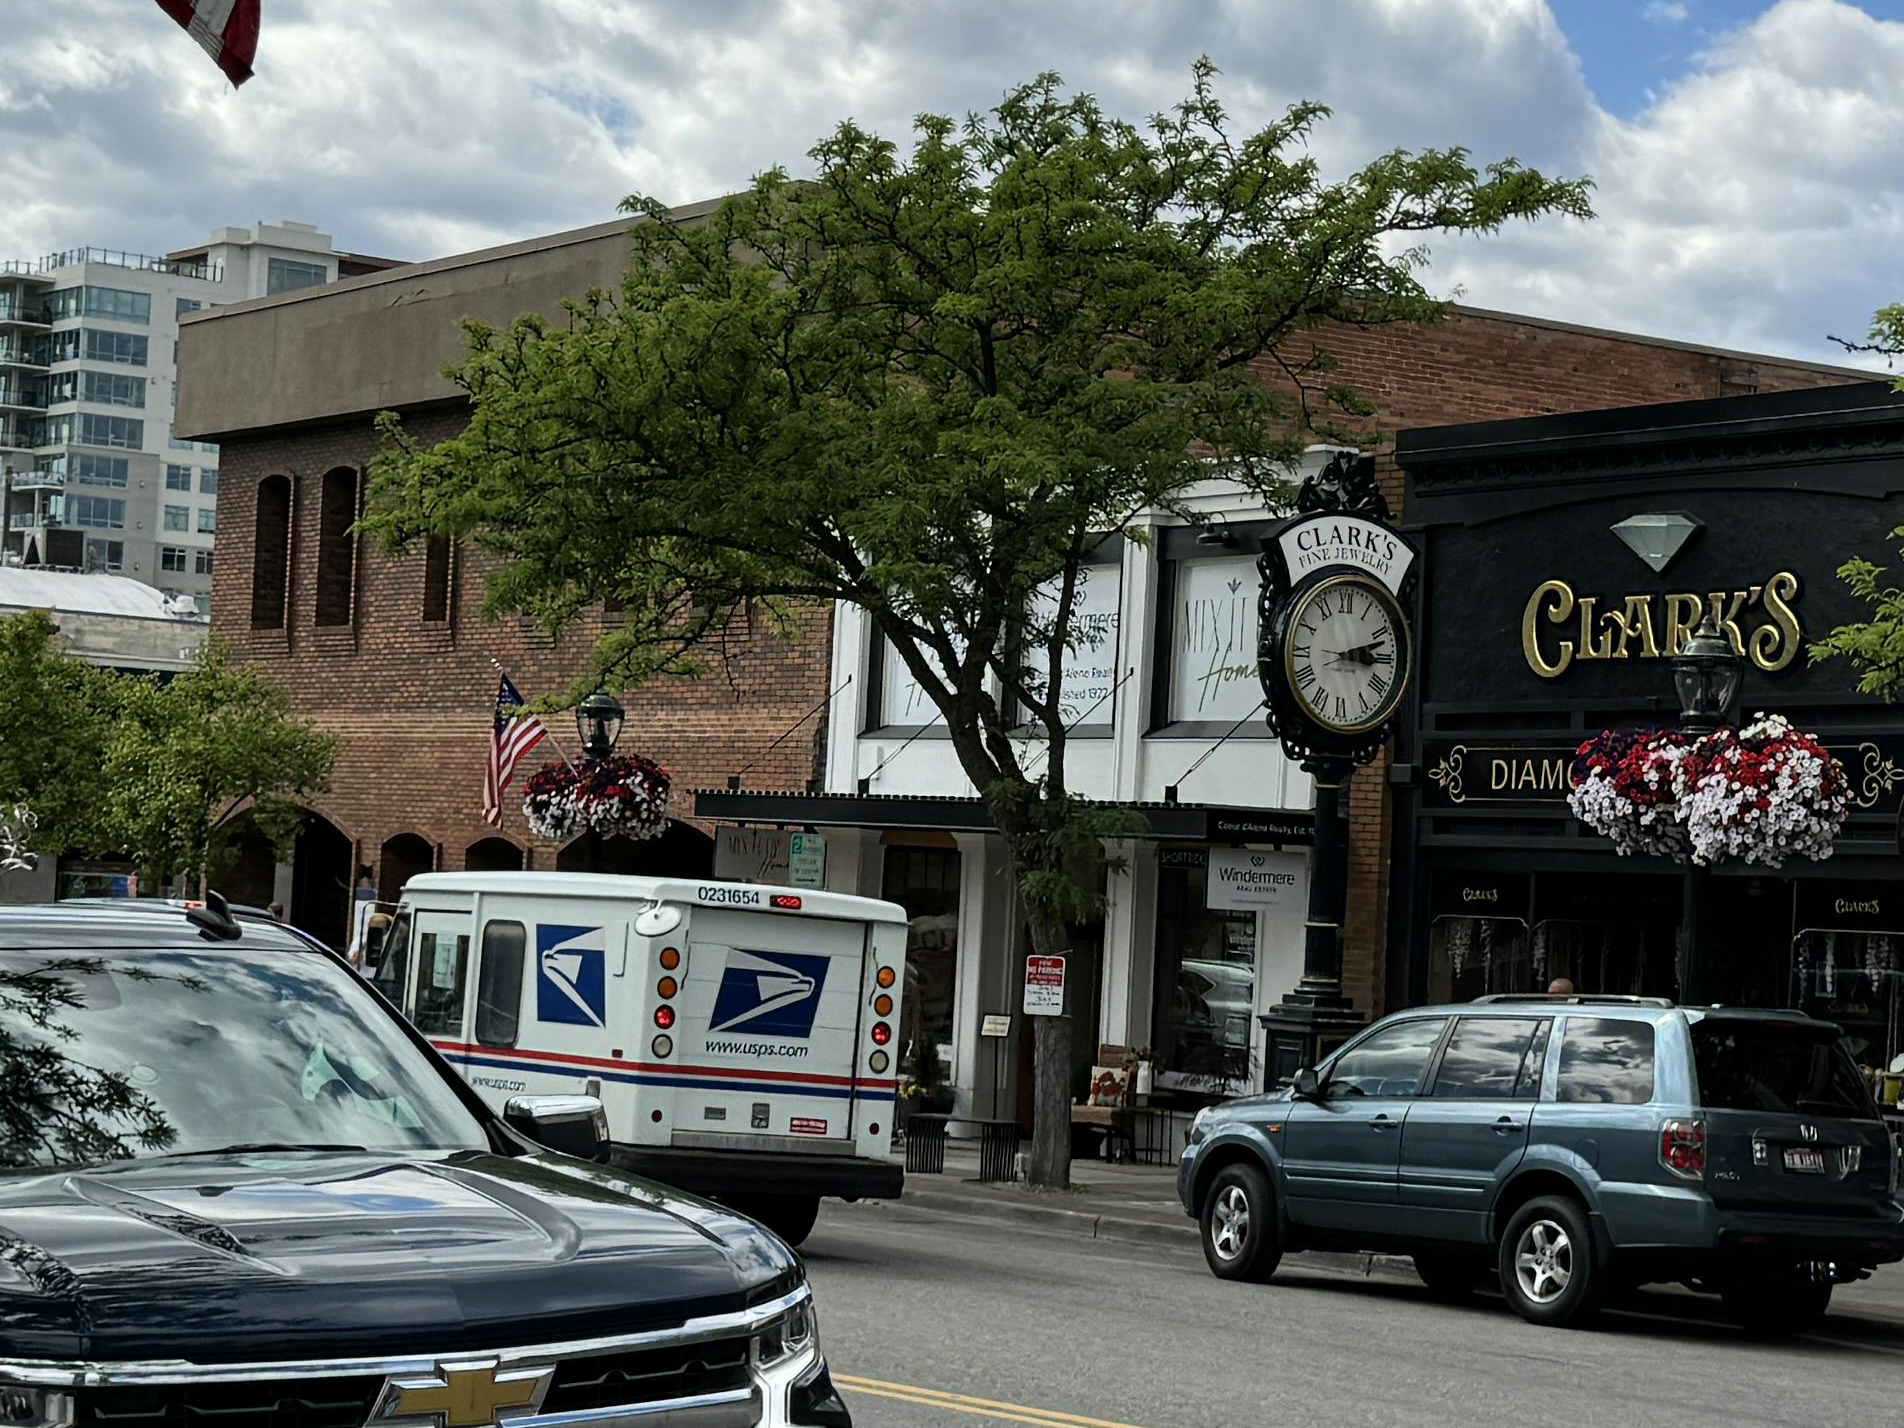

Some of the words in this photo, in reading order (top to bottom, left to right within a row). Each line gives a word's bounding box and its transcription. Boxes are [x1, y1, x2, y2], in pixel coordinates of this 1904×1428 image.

[1297, 525, 1397, 560] CLARK'S
[1299, 548, 1331, 568] FINE
[1335, 548, 1392, 575] JEWELRY
[1522, 571, 1799, 677] CLARK'S
[1491, 759, 1575, 790] DIAM
[1219, 868, 1295, 885] Windermere
[698, 887, 760, 904] 0231654
[705, 1041, 808, 1057] www.usps.com
